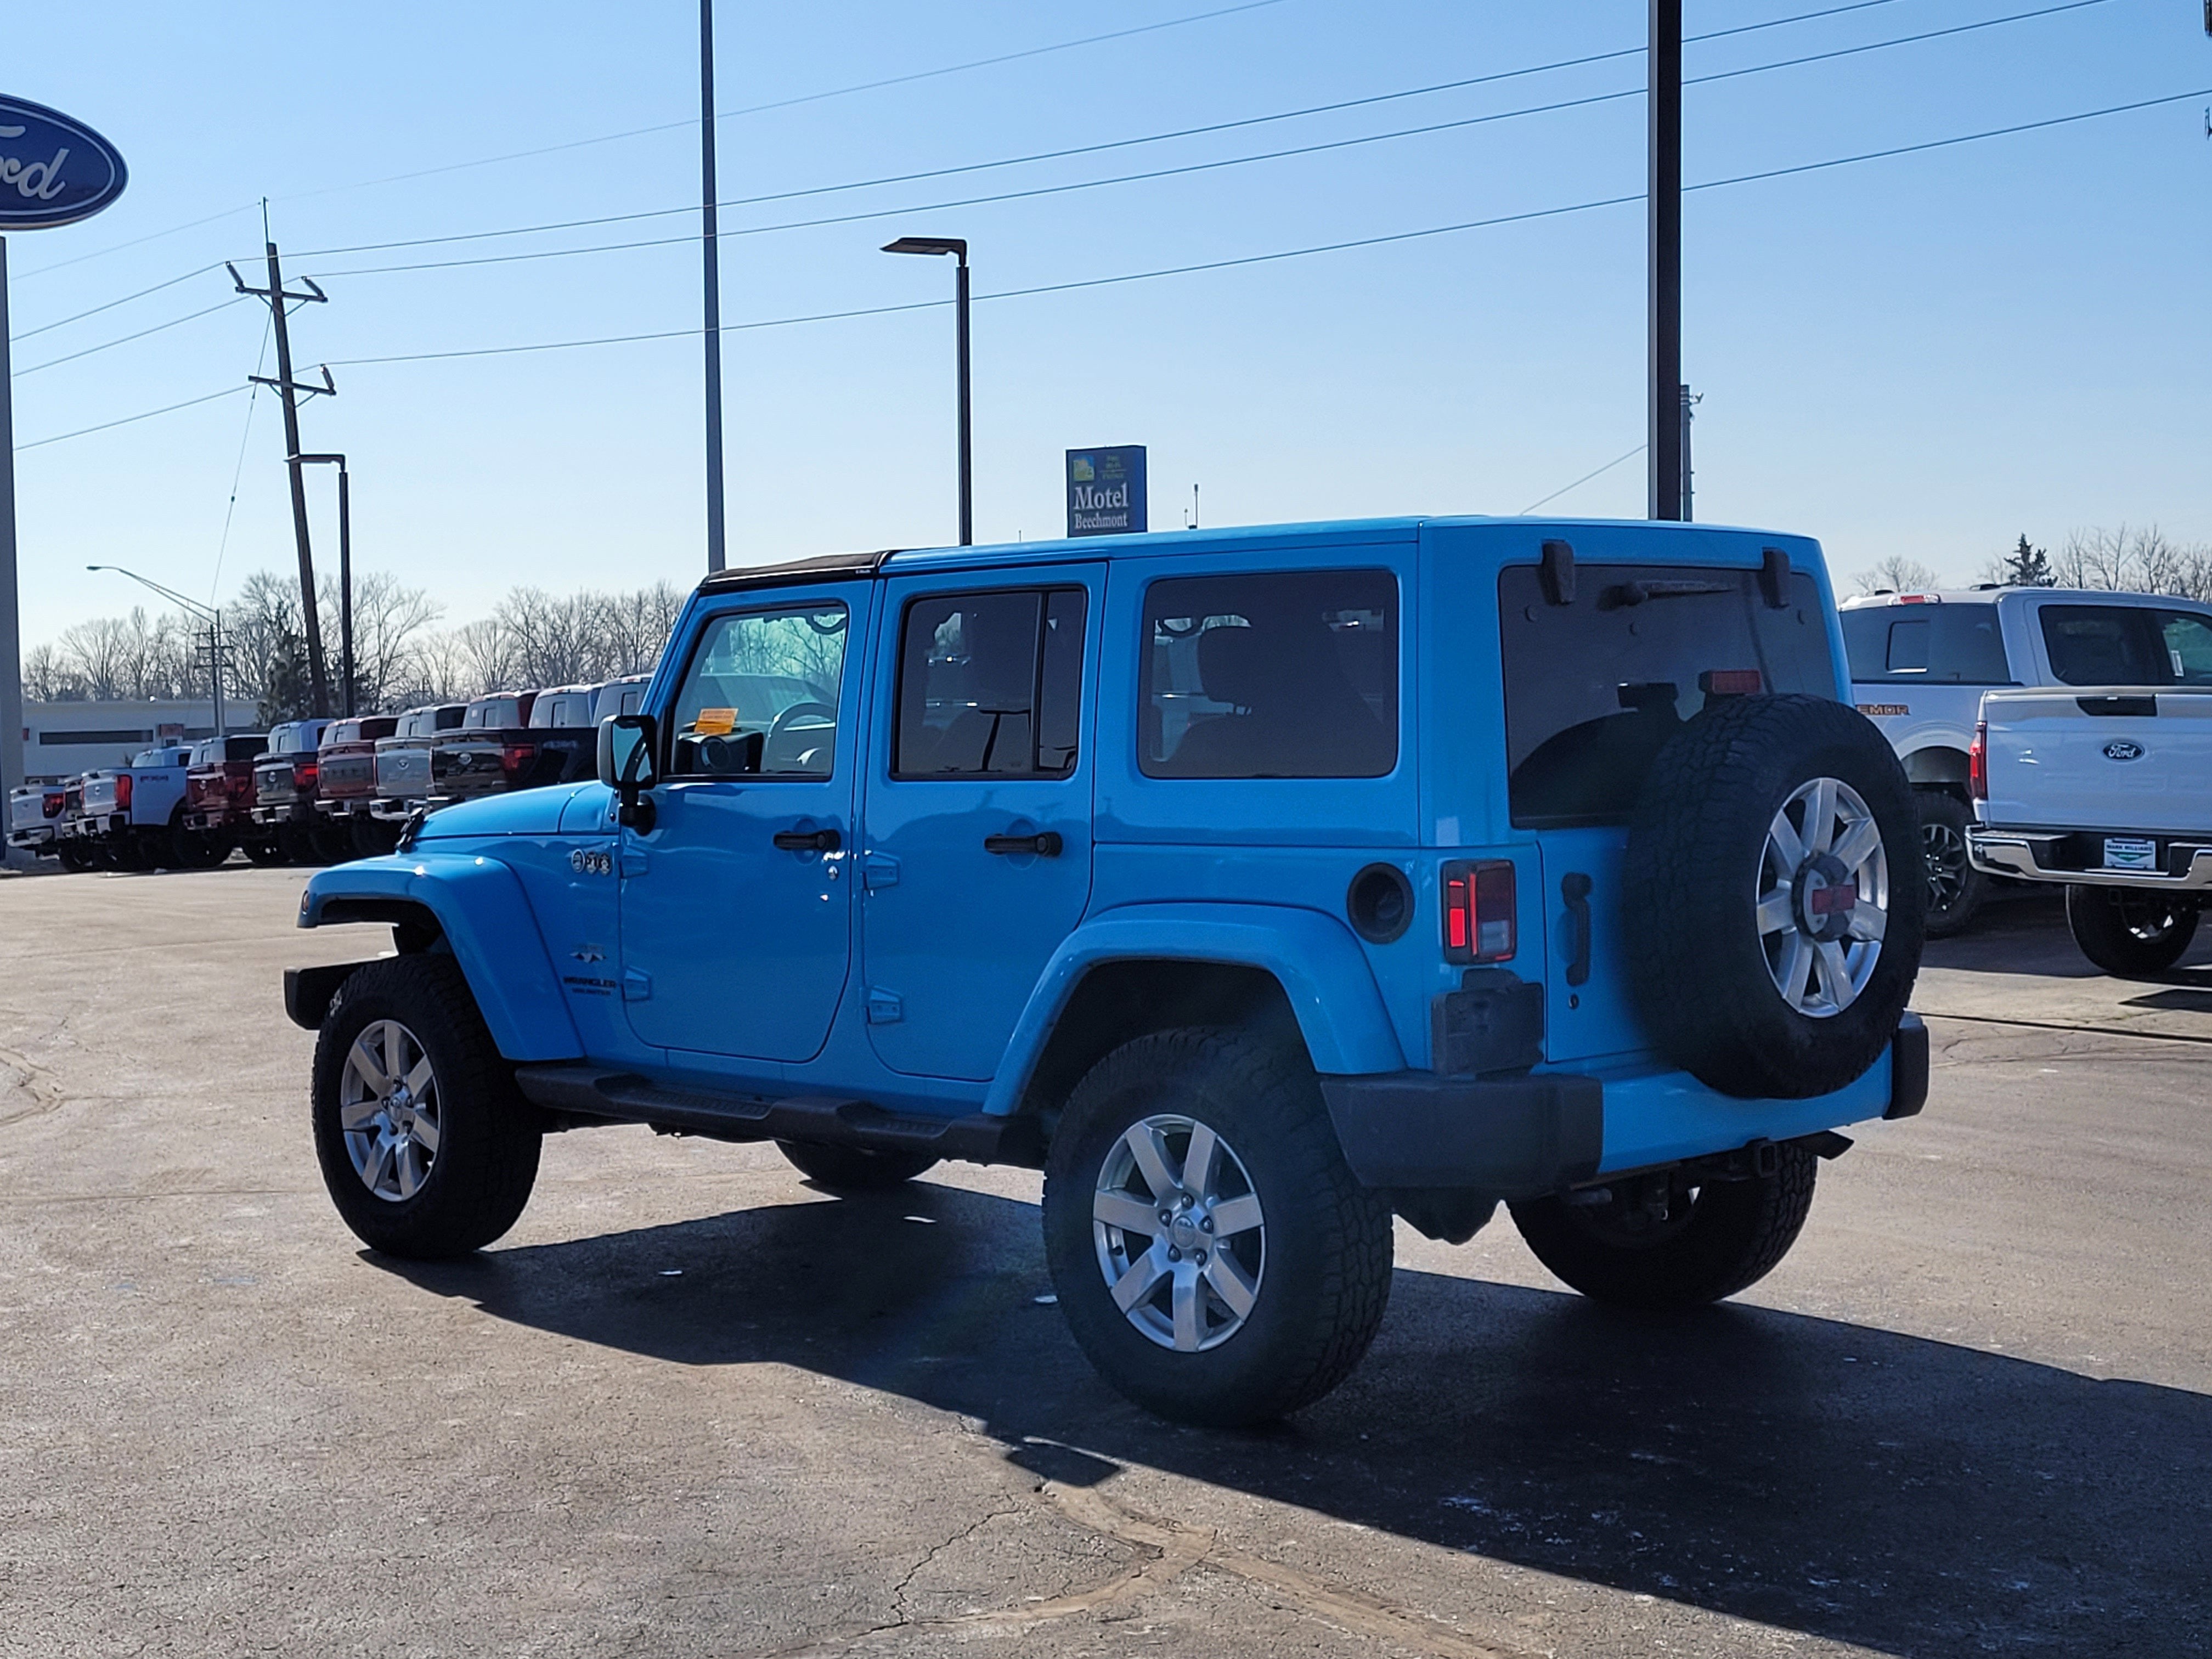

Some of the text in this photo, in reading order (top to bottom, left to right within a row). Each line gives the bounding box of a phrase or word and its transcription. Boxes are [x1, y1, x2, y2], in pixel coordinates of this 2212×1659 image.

[0, 126, 70, 200] rd
[1073, 482, 1129, 510] Motel
[1074, 511, 1128, 529] Beechmont
[1855, 704, 1910, 715] EMOR
[2108, 743, 2137, 758] Ford
